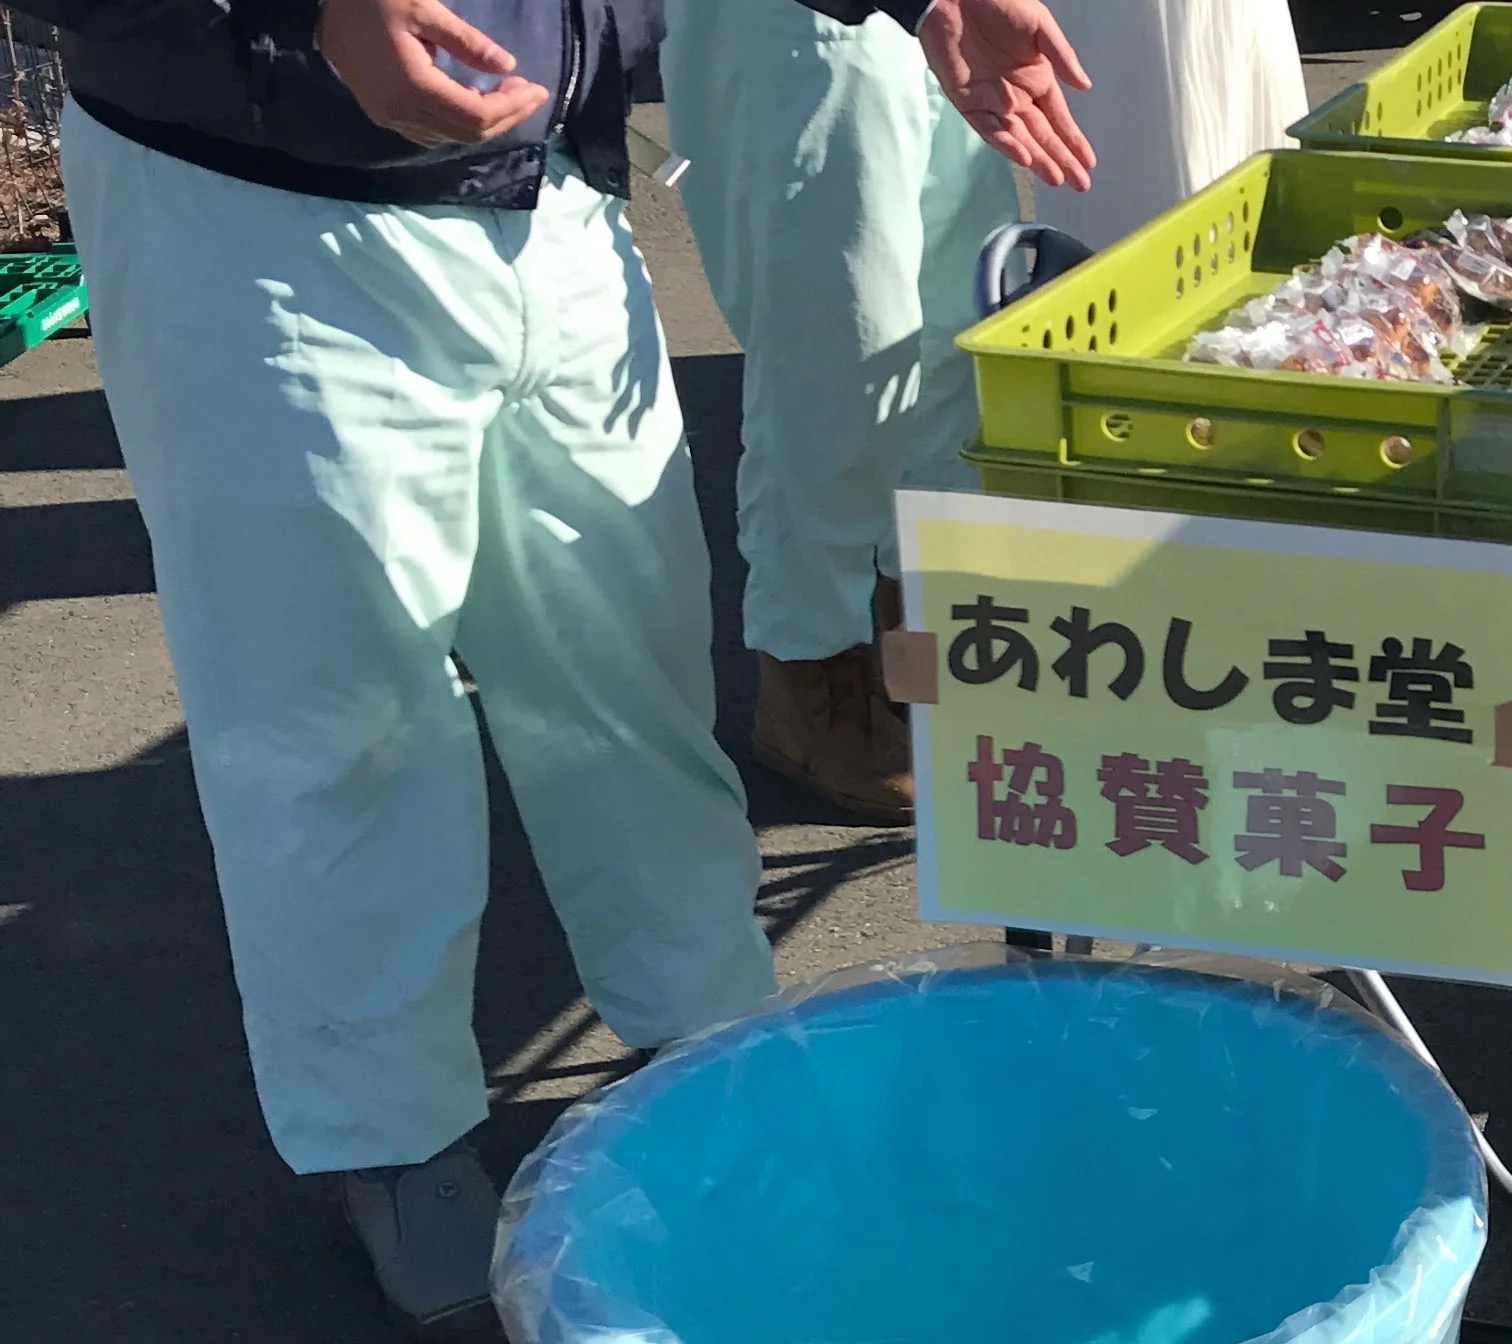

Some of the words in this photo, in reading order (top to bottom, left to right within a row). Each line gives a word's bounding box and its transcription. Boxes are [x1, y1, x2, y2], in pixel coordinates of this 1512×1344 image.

[948, 595, 1474, 744] あわしま堂
[968, 735, 1485, 891] 協賛菓子
